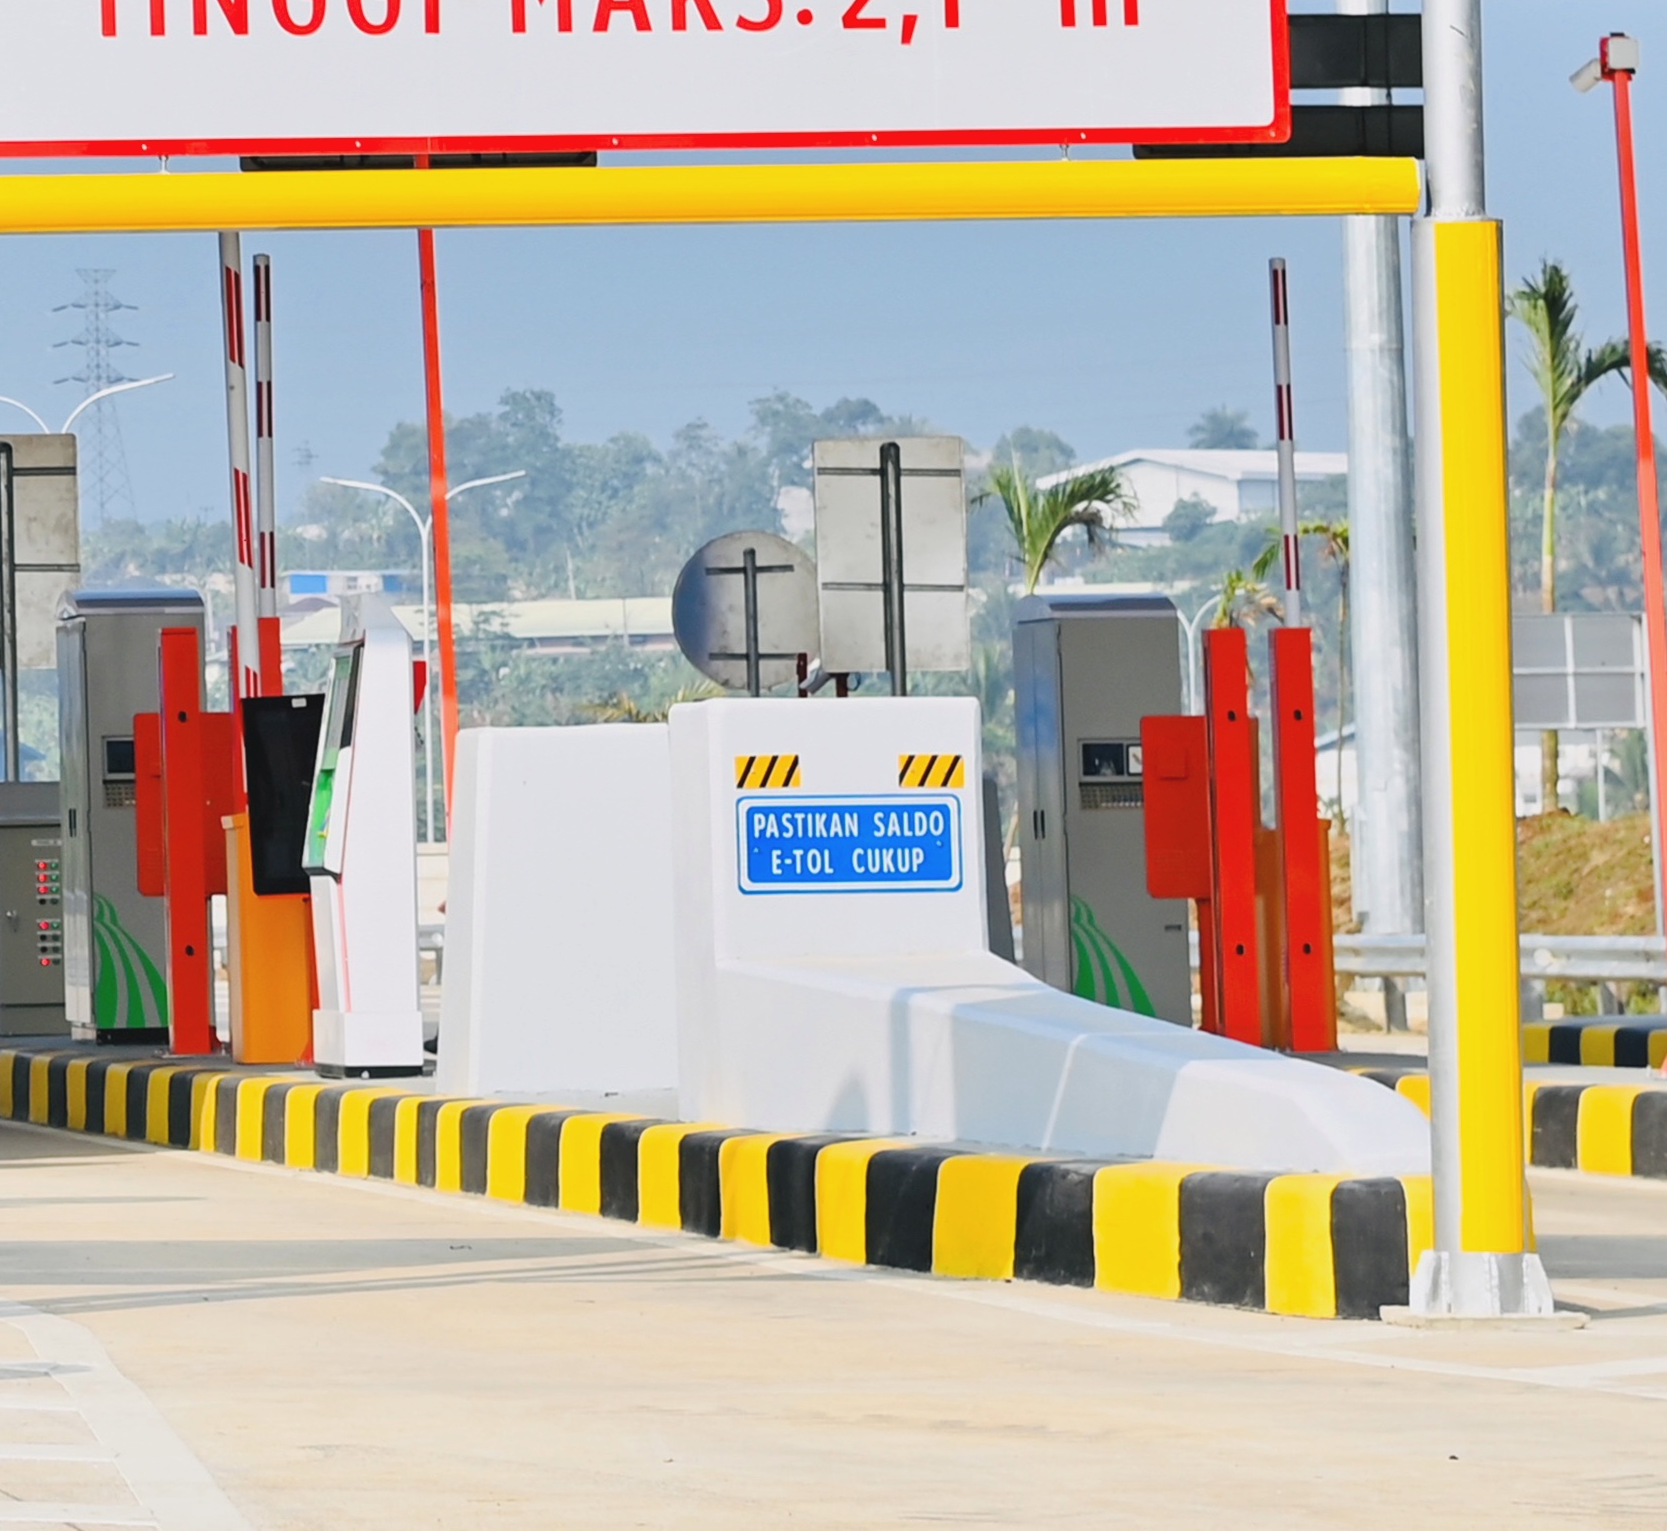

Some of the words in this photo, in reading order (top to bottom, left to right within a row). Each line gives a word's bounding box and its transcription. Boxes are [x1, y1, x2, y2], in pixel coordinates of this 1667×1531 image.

[754, 813, 858, 838] PASTIKAN
[874, 811, 944, 837] SALDO
[771, 848, 833, 875] E-TOL
[852, 847, 924, 873] CUKUP
